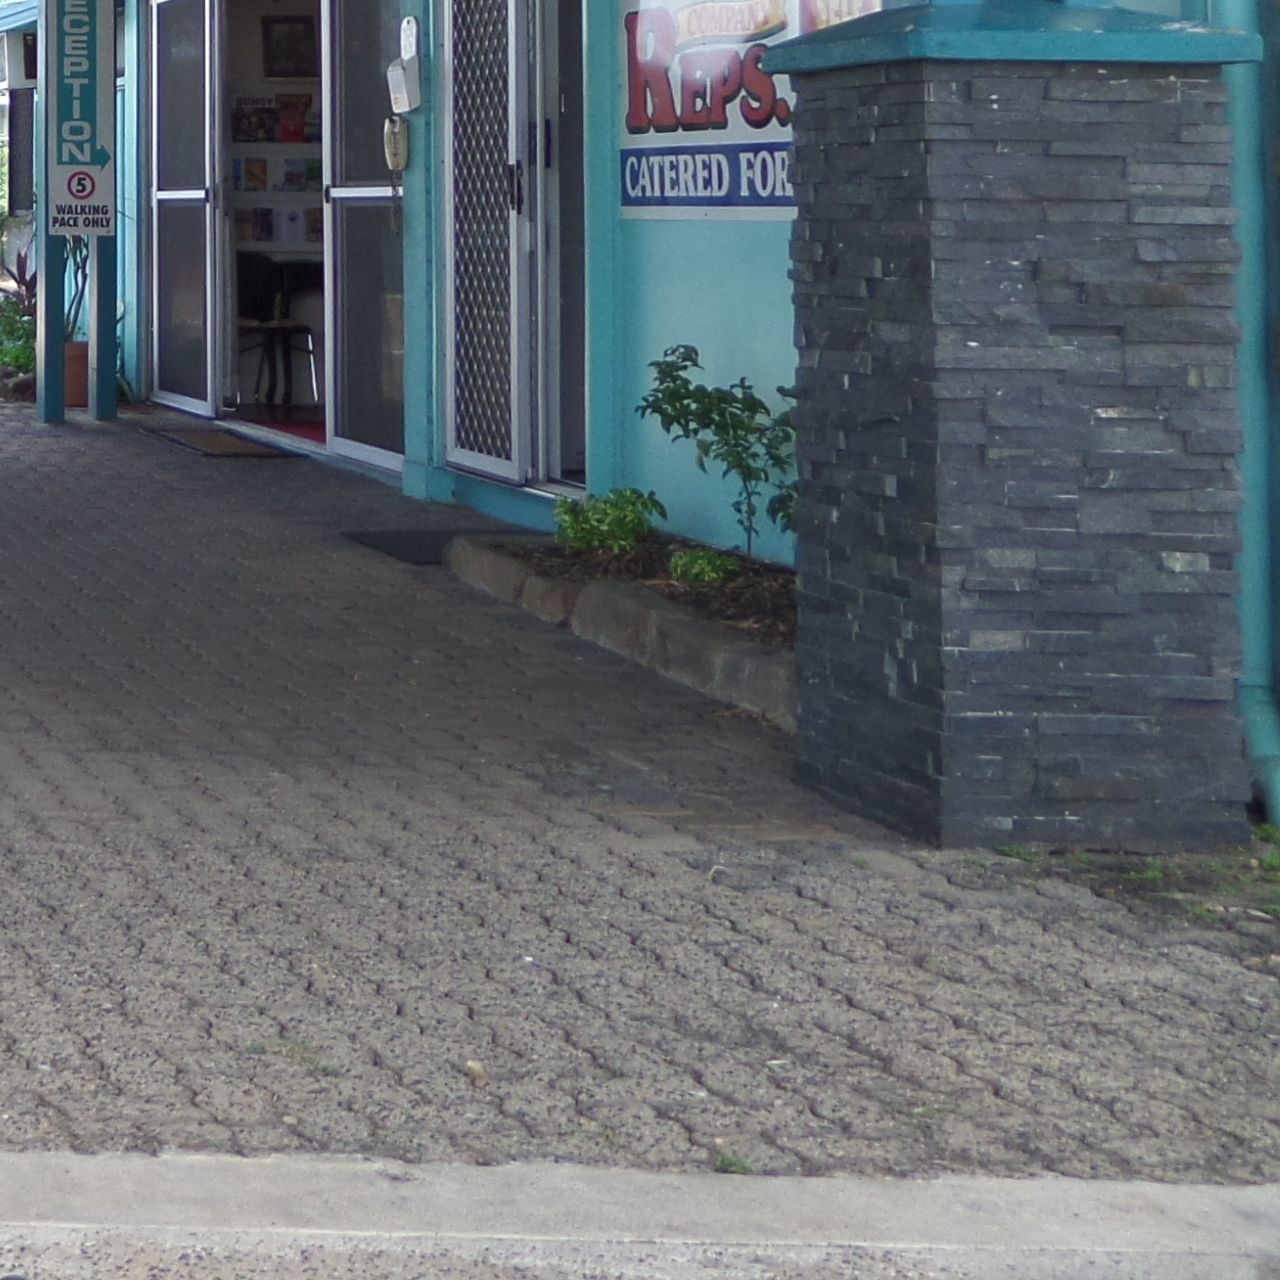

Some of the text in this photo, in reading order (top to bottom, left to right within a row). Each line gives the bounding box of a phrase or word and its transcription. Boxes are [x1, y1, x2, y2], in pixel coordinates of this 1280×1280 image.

[624, 150, 793, 198] CATERED FOR
[75, 176, 88, 195] 5
[55, 204, 109, 216] WALKING
[52, 216, 111, 228] PACE ONLY
